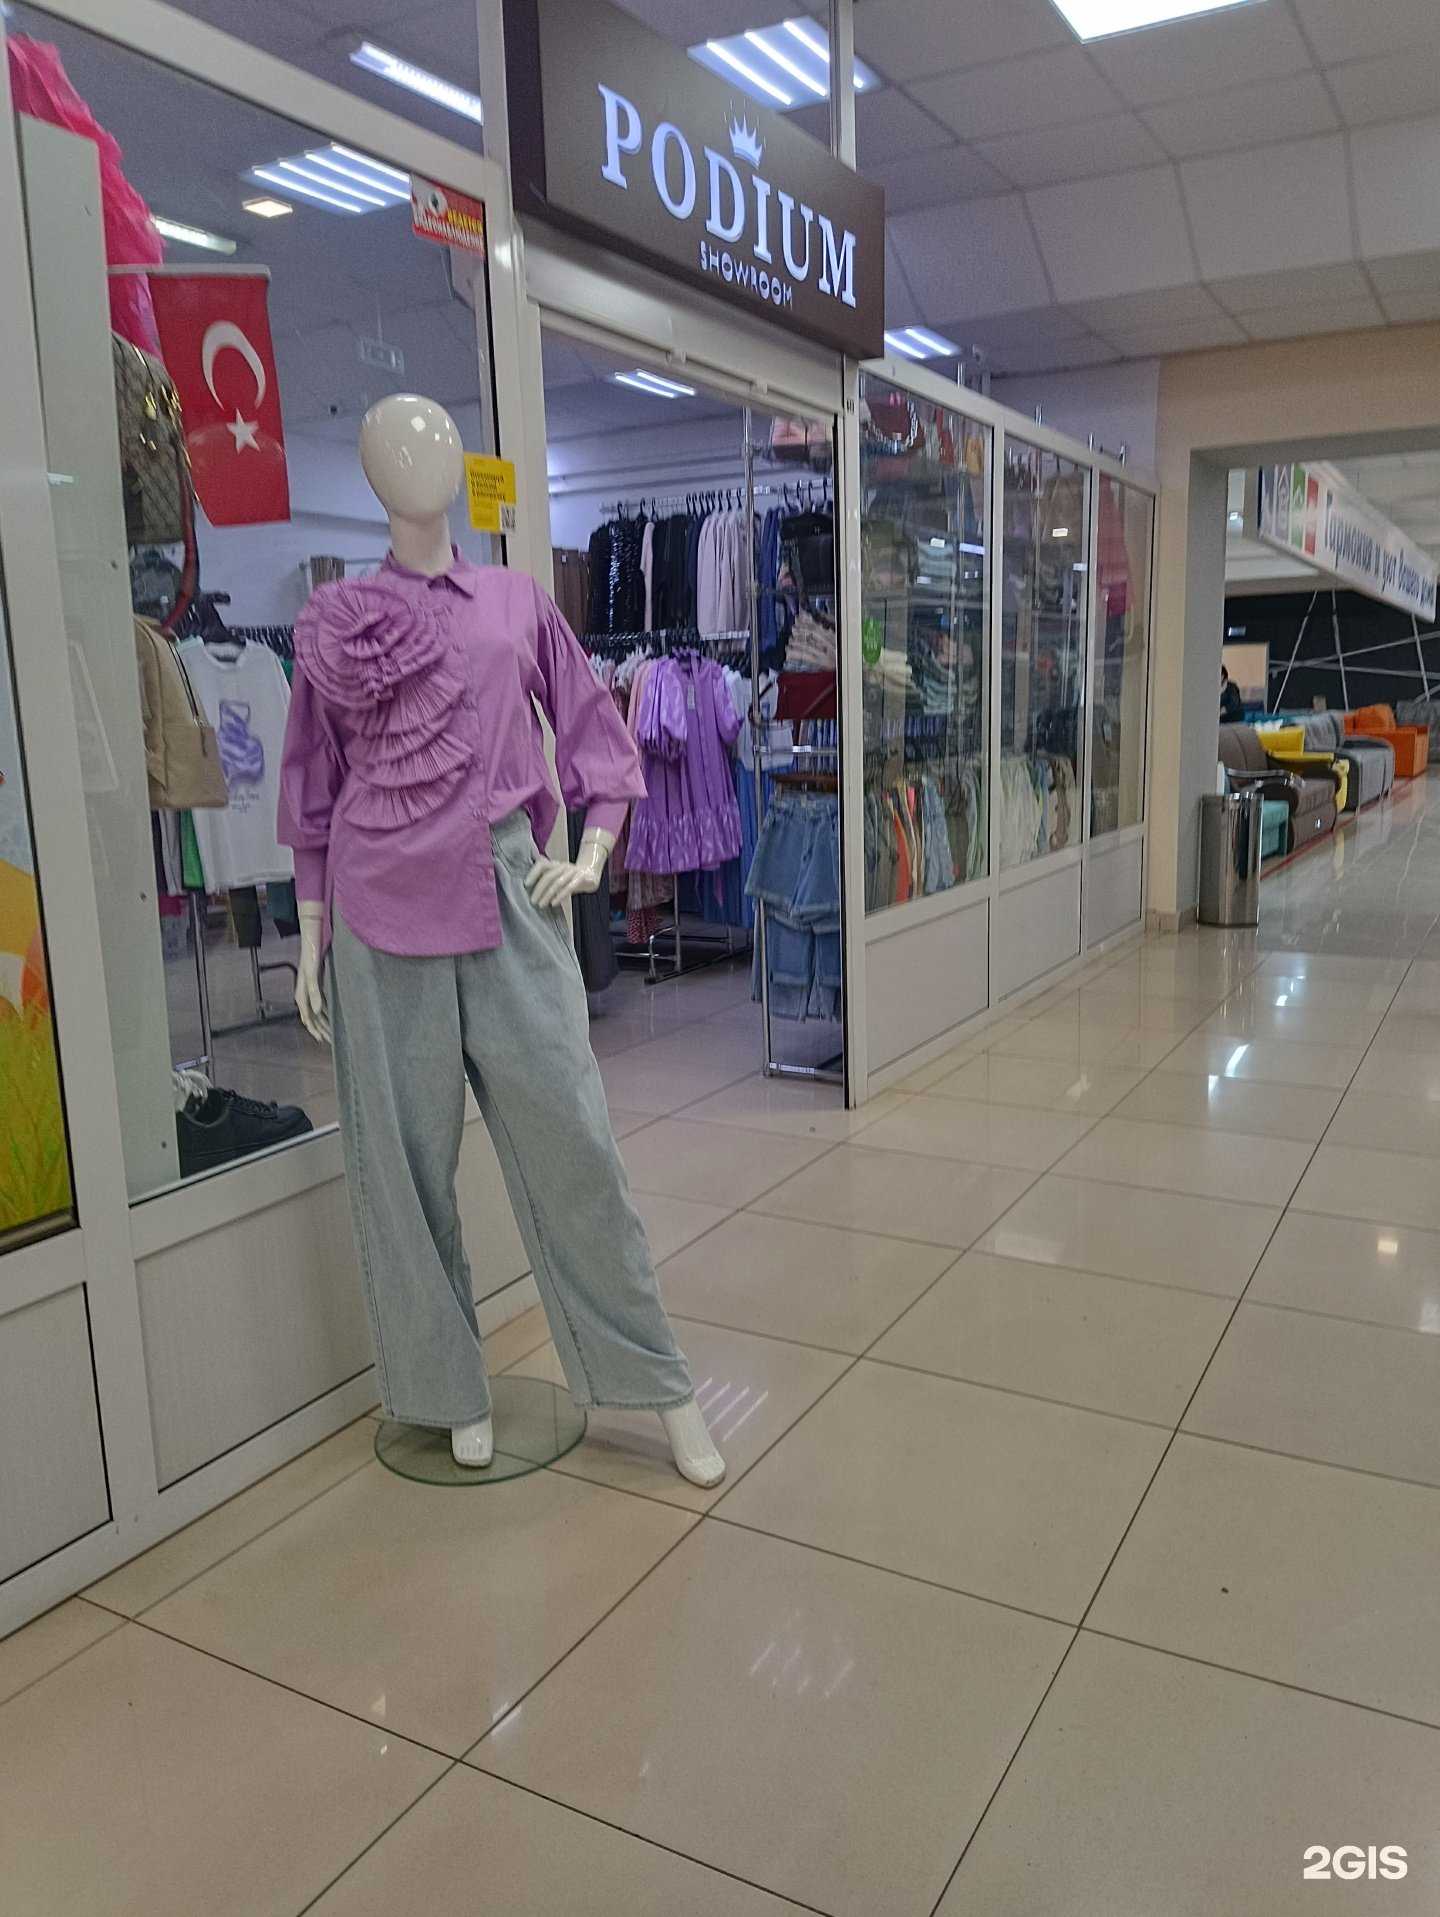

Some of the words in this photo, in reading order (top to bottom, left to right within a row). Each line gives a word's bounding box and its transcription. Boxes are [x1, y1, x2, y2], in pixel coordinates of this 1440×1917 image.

[598, 82, 857, 309] PODIUM
[700, 241, 793, 310] SHOWROOM
[1324, 489, 1373, 573] Гармония
